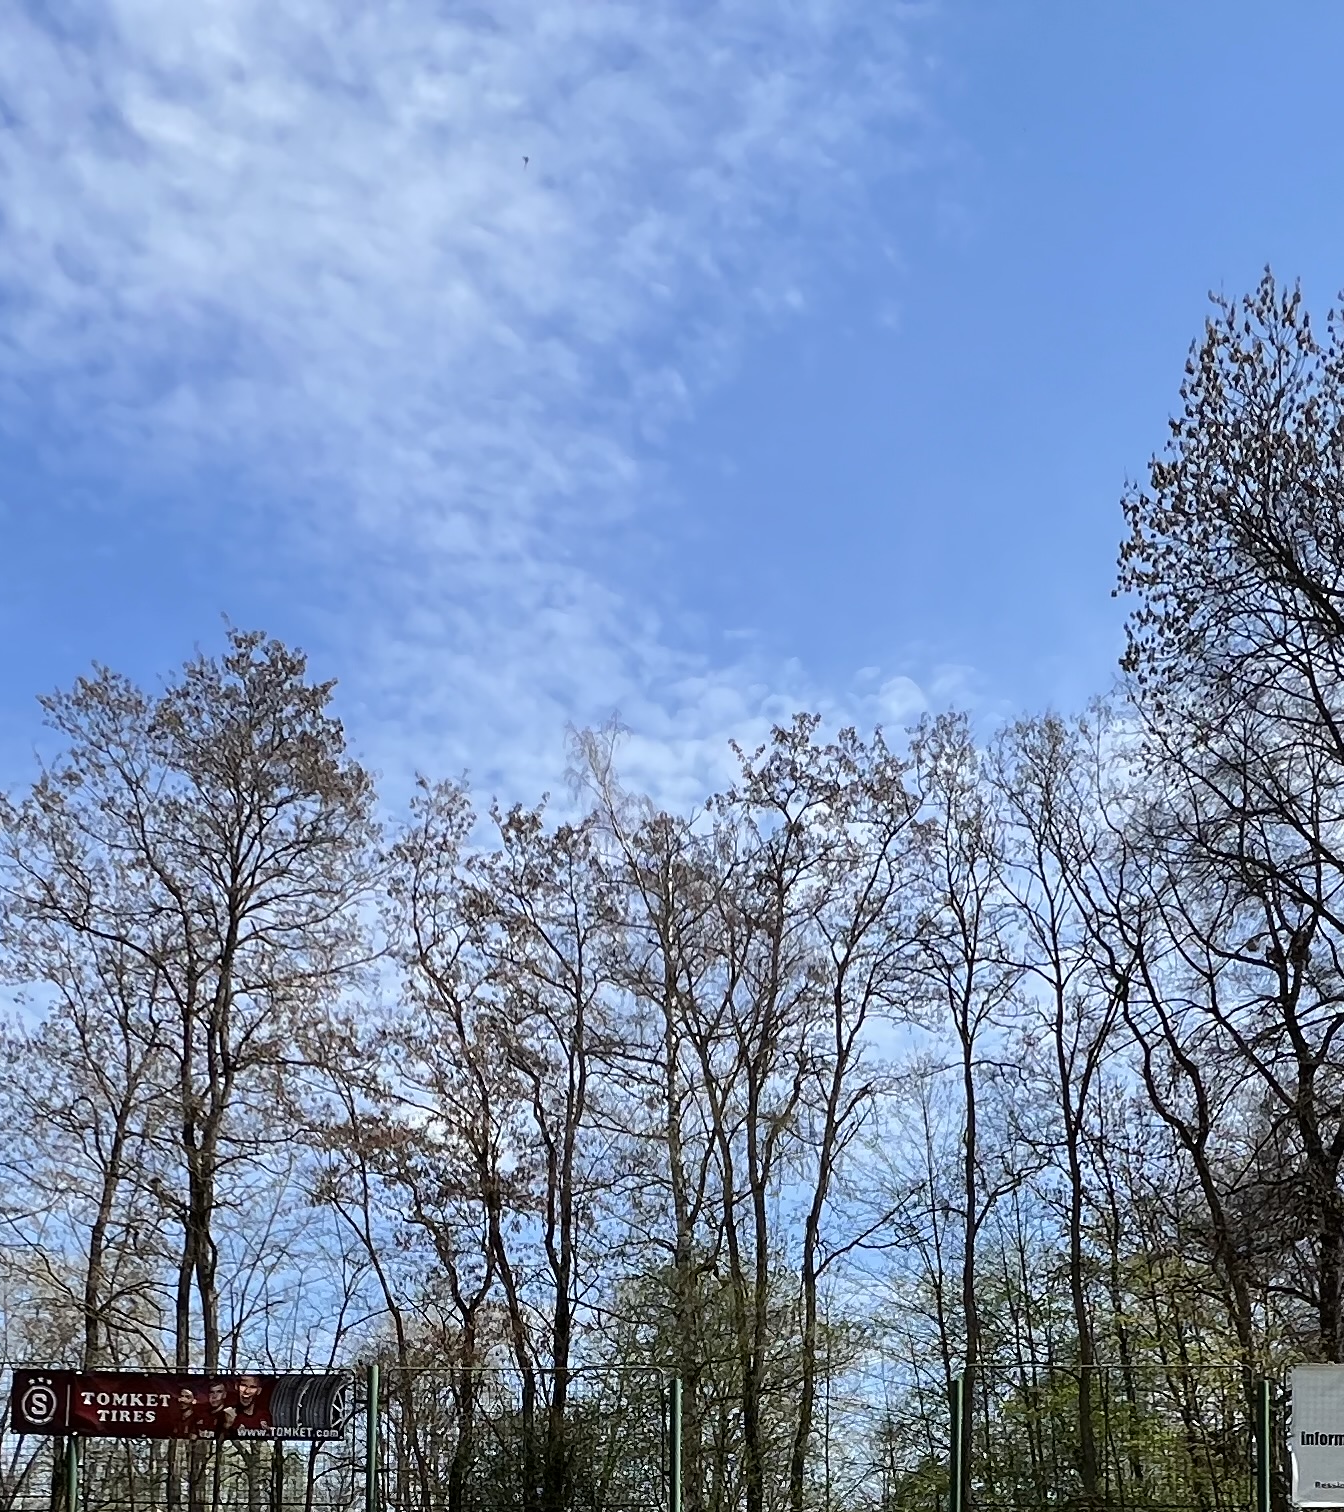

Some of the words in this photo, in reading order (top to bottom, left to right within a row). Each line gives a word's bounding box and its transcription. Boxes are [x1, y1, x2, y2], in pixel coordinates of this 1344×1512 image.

[81, 1391, 171, 1407] TOMKET
[97, 1410, 156, 1422] TIRES
[237, 1426, 339, 1437] www.TOMKET.com
